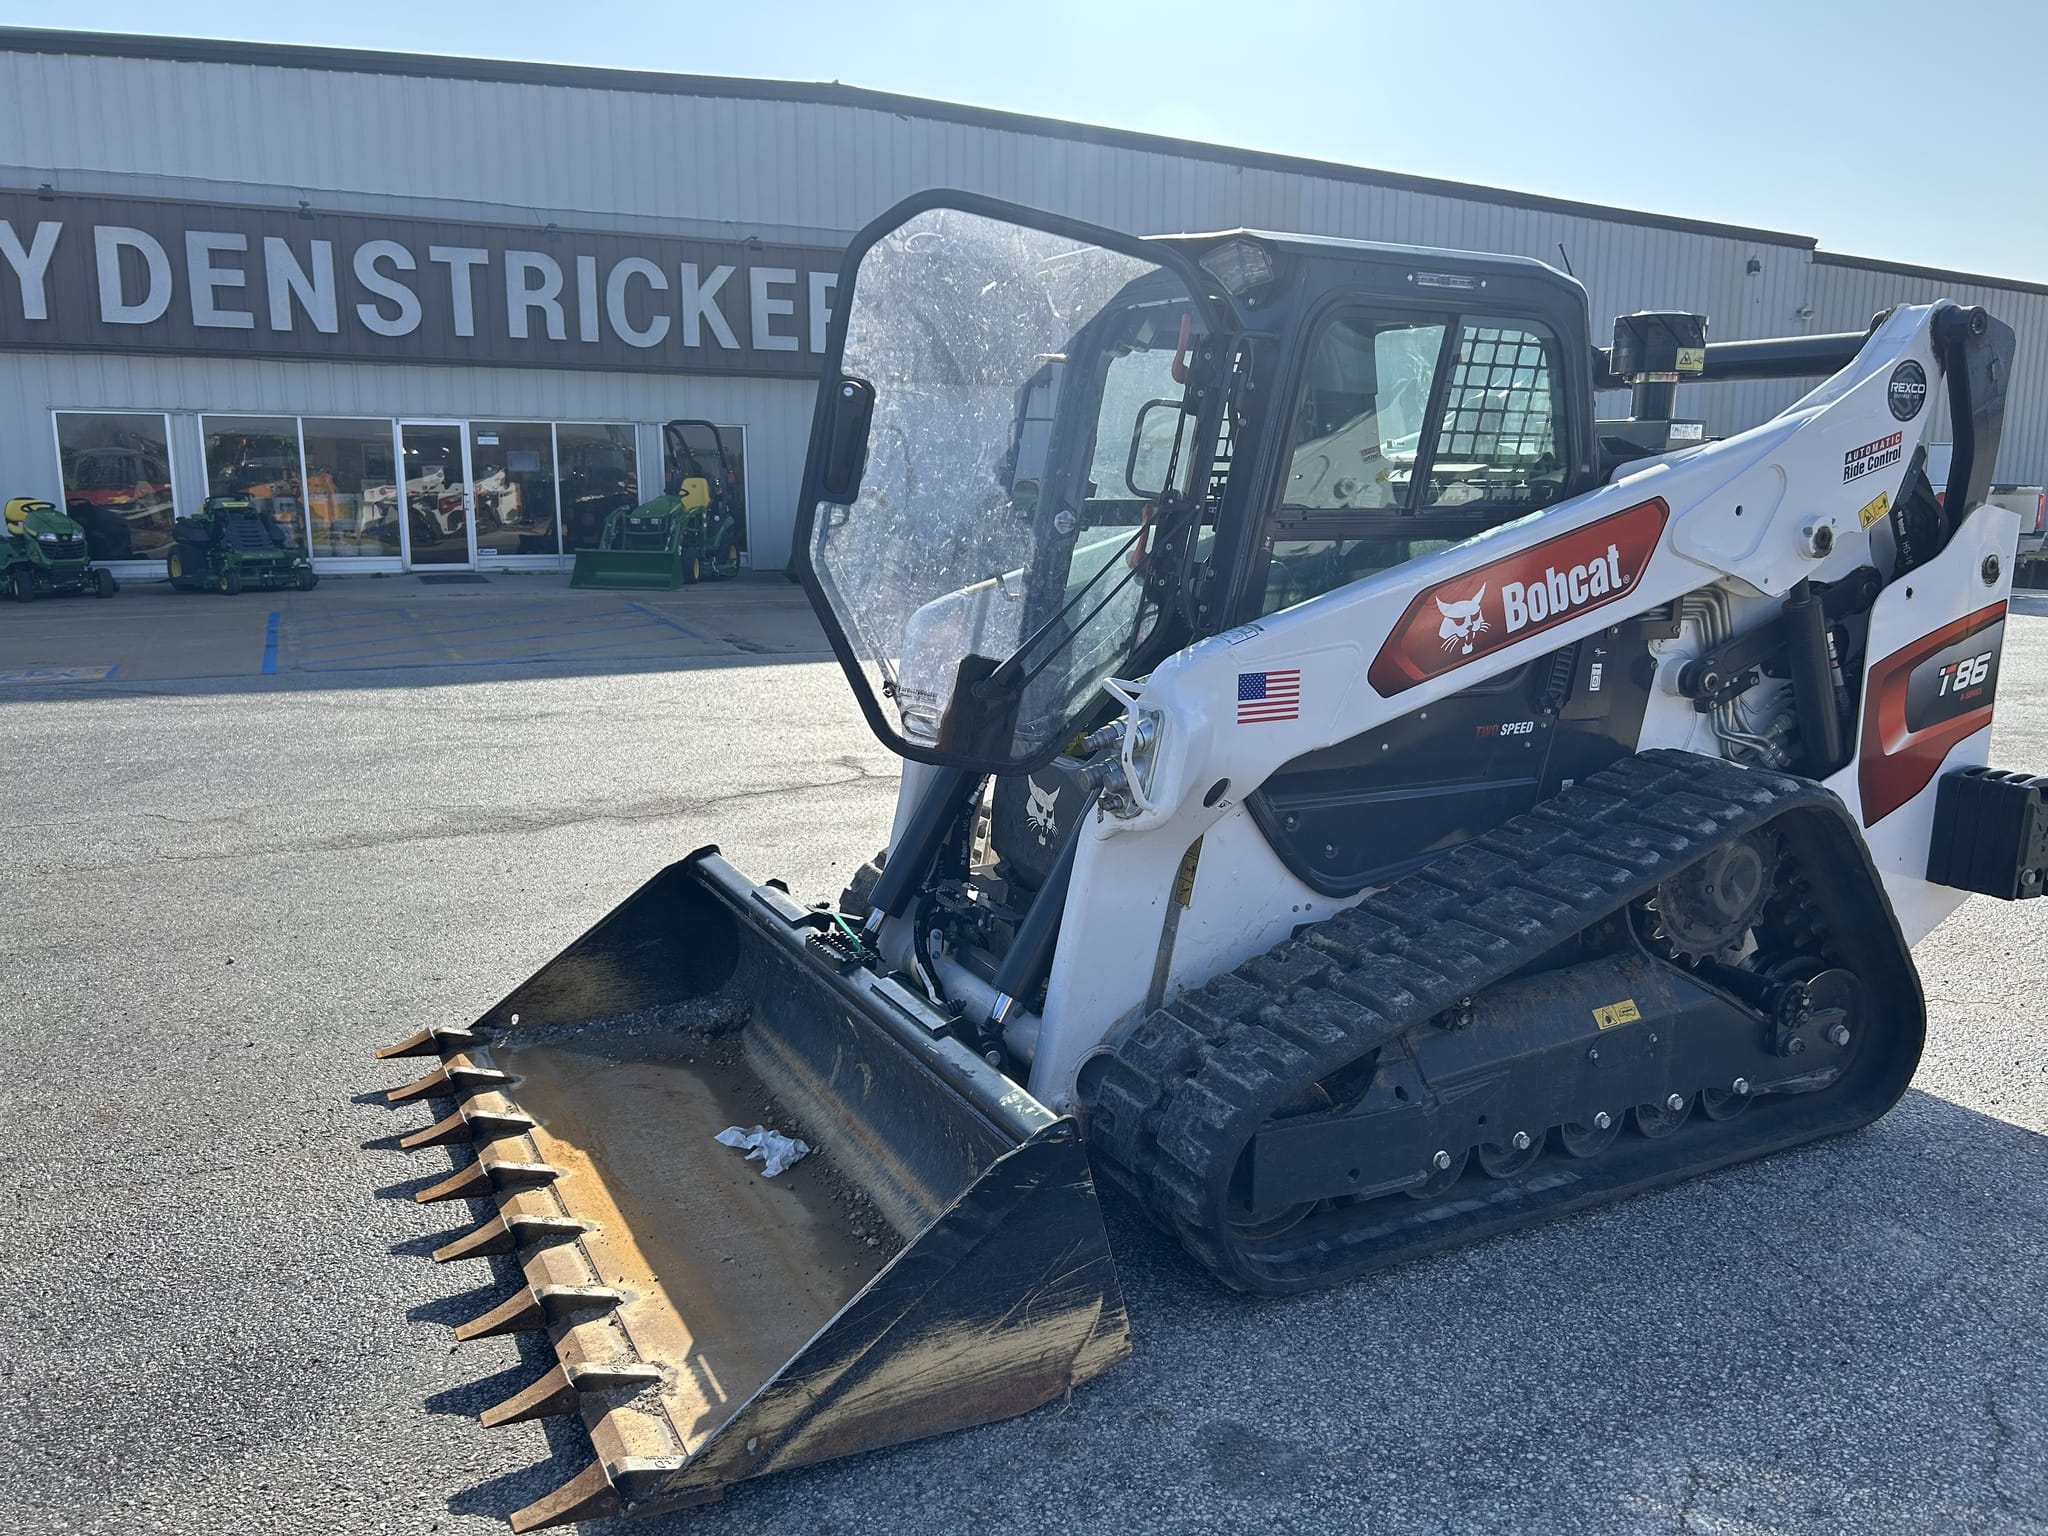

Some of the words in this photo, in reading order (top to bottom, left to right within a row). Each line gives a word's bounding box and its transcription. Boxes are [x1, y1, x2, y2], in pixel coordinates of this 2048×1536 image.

[1890, 382, 1926, 394] REXCO
[1843, 462, 1865, 481] Ride
[1867, 445, 1902, 471] Control
[1846, 433, 1901, 462] AUTOMATIC
[1502, 543, 1623, 634] Bobcat
[1939, 652, 1992, 697] T86
[1476, 725, 1499, 737] TWO
[1500, 721, 1534, 736] SPEED
